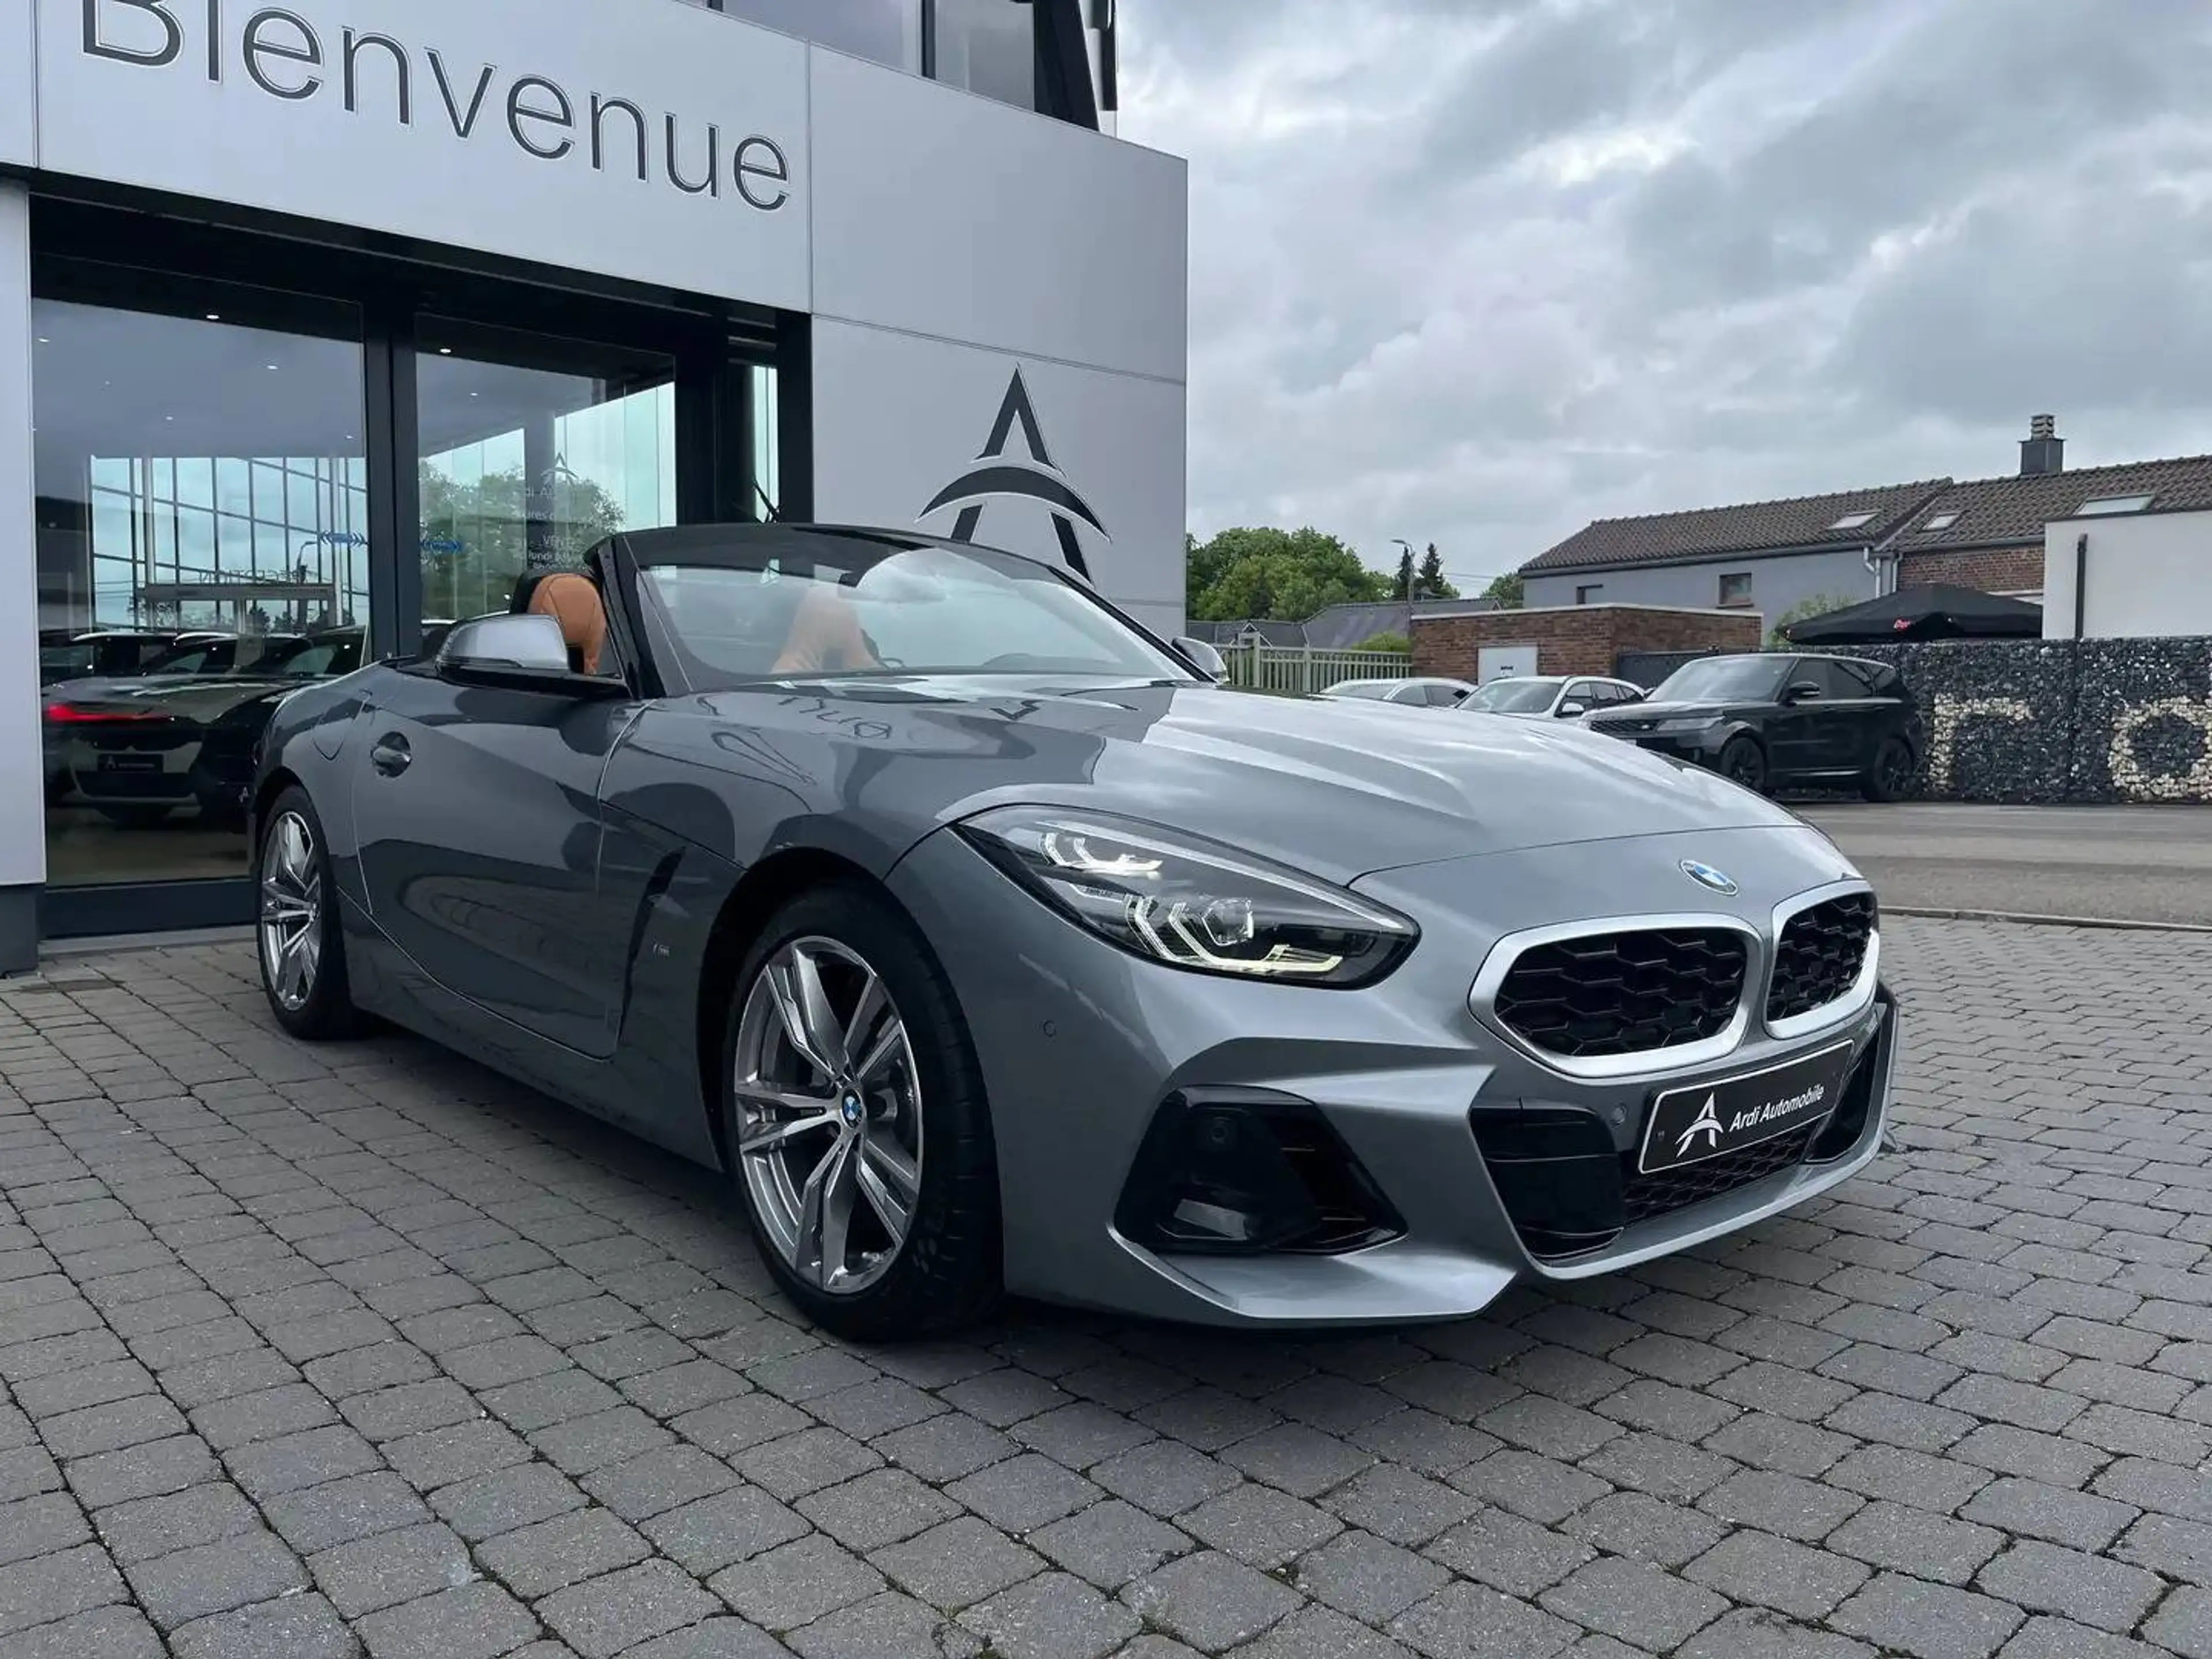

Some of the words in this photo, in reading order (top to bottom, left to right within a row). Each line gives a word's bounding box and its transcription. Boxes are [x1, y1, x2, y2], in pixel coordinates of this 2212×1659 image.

[82, 0, 789, 211] Bienvenue
[1729, 1105, 1762, 1132] Ardi
[1759, 1083, 1825, 1123] Automobile
